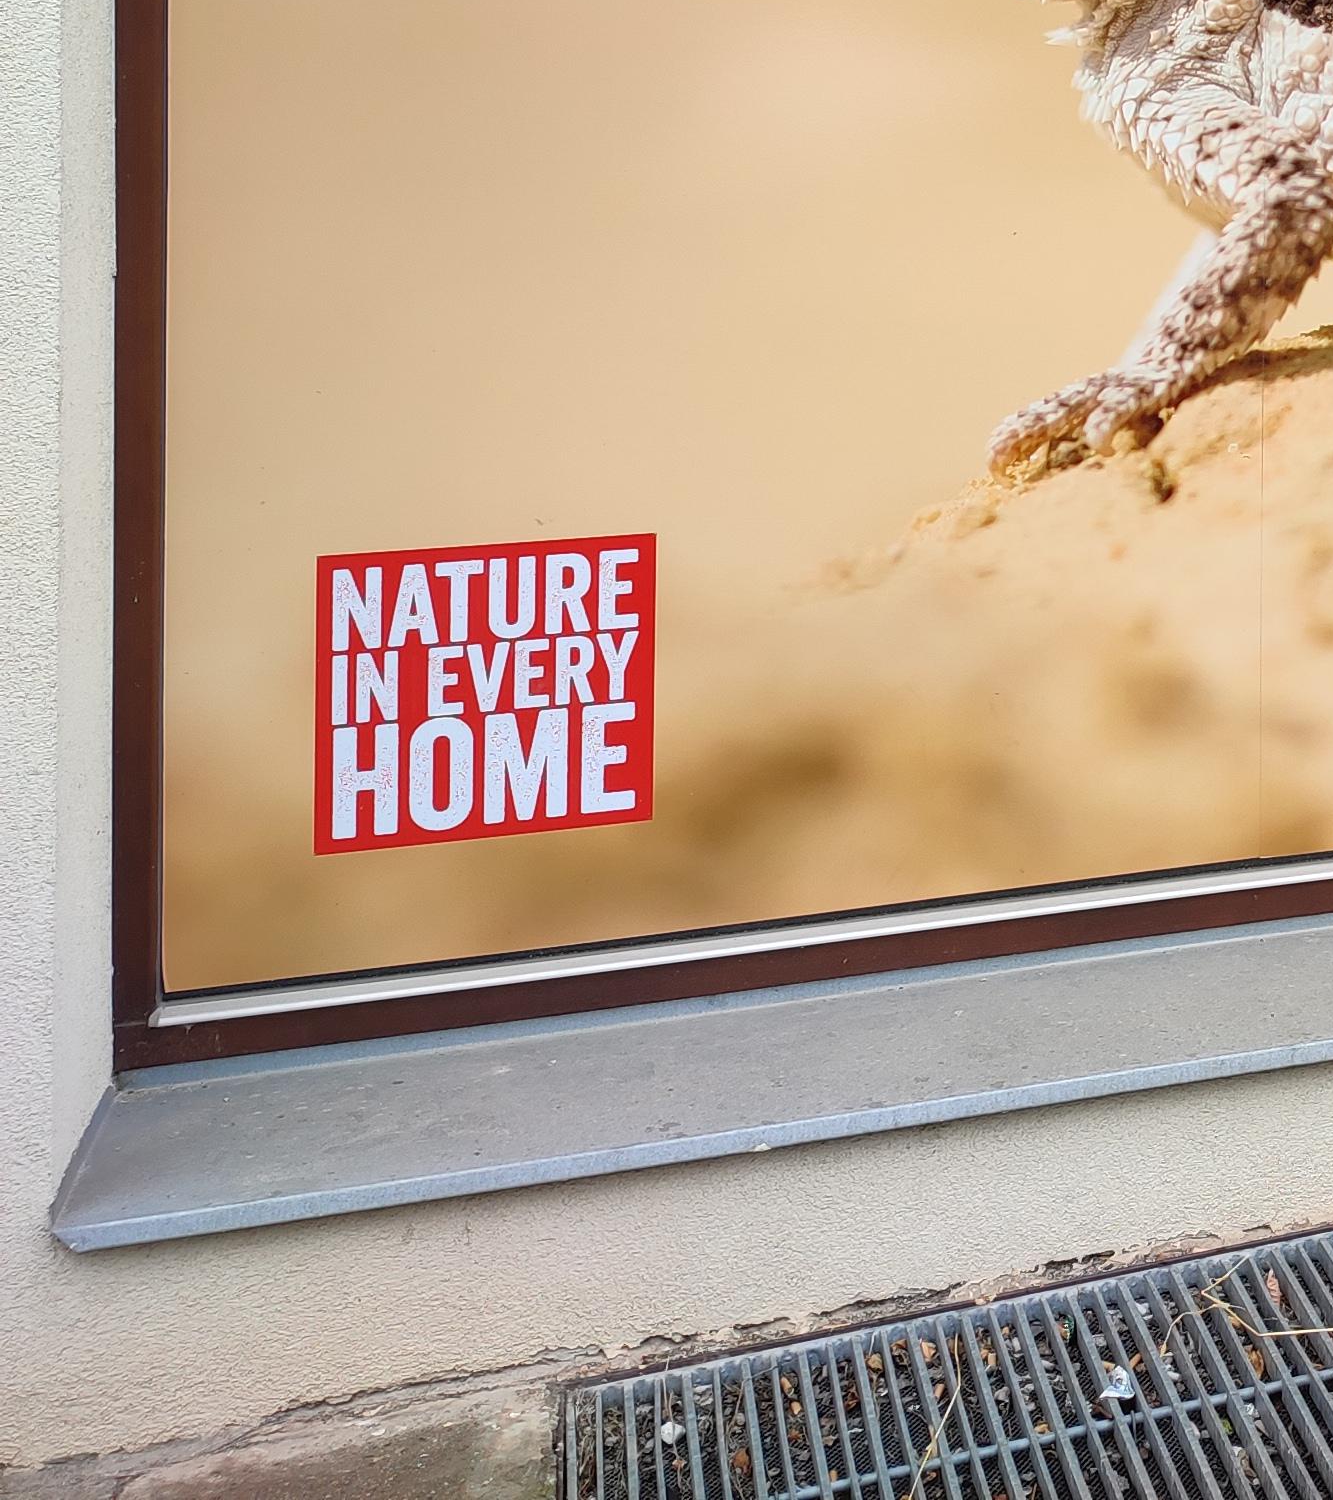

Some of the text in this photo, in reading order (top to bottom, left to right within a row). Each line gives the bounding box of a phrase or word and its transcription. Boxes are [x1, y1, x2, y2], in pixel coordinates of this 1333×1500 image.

[331, 548, 640, 652] NATURE
[331, 630, 640, 726] IN EVERY
[331, 702, 636, 840] HOME
